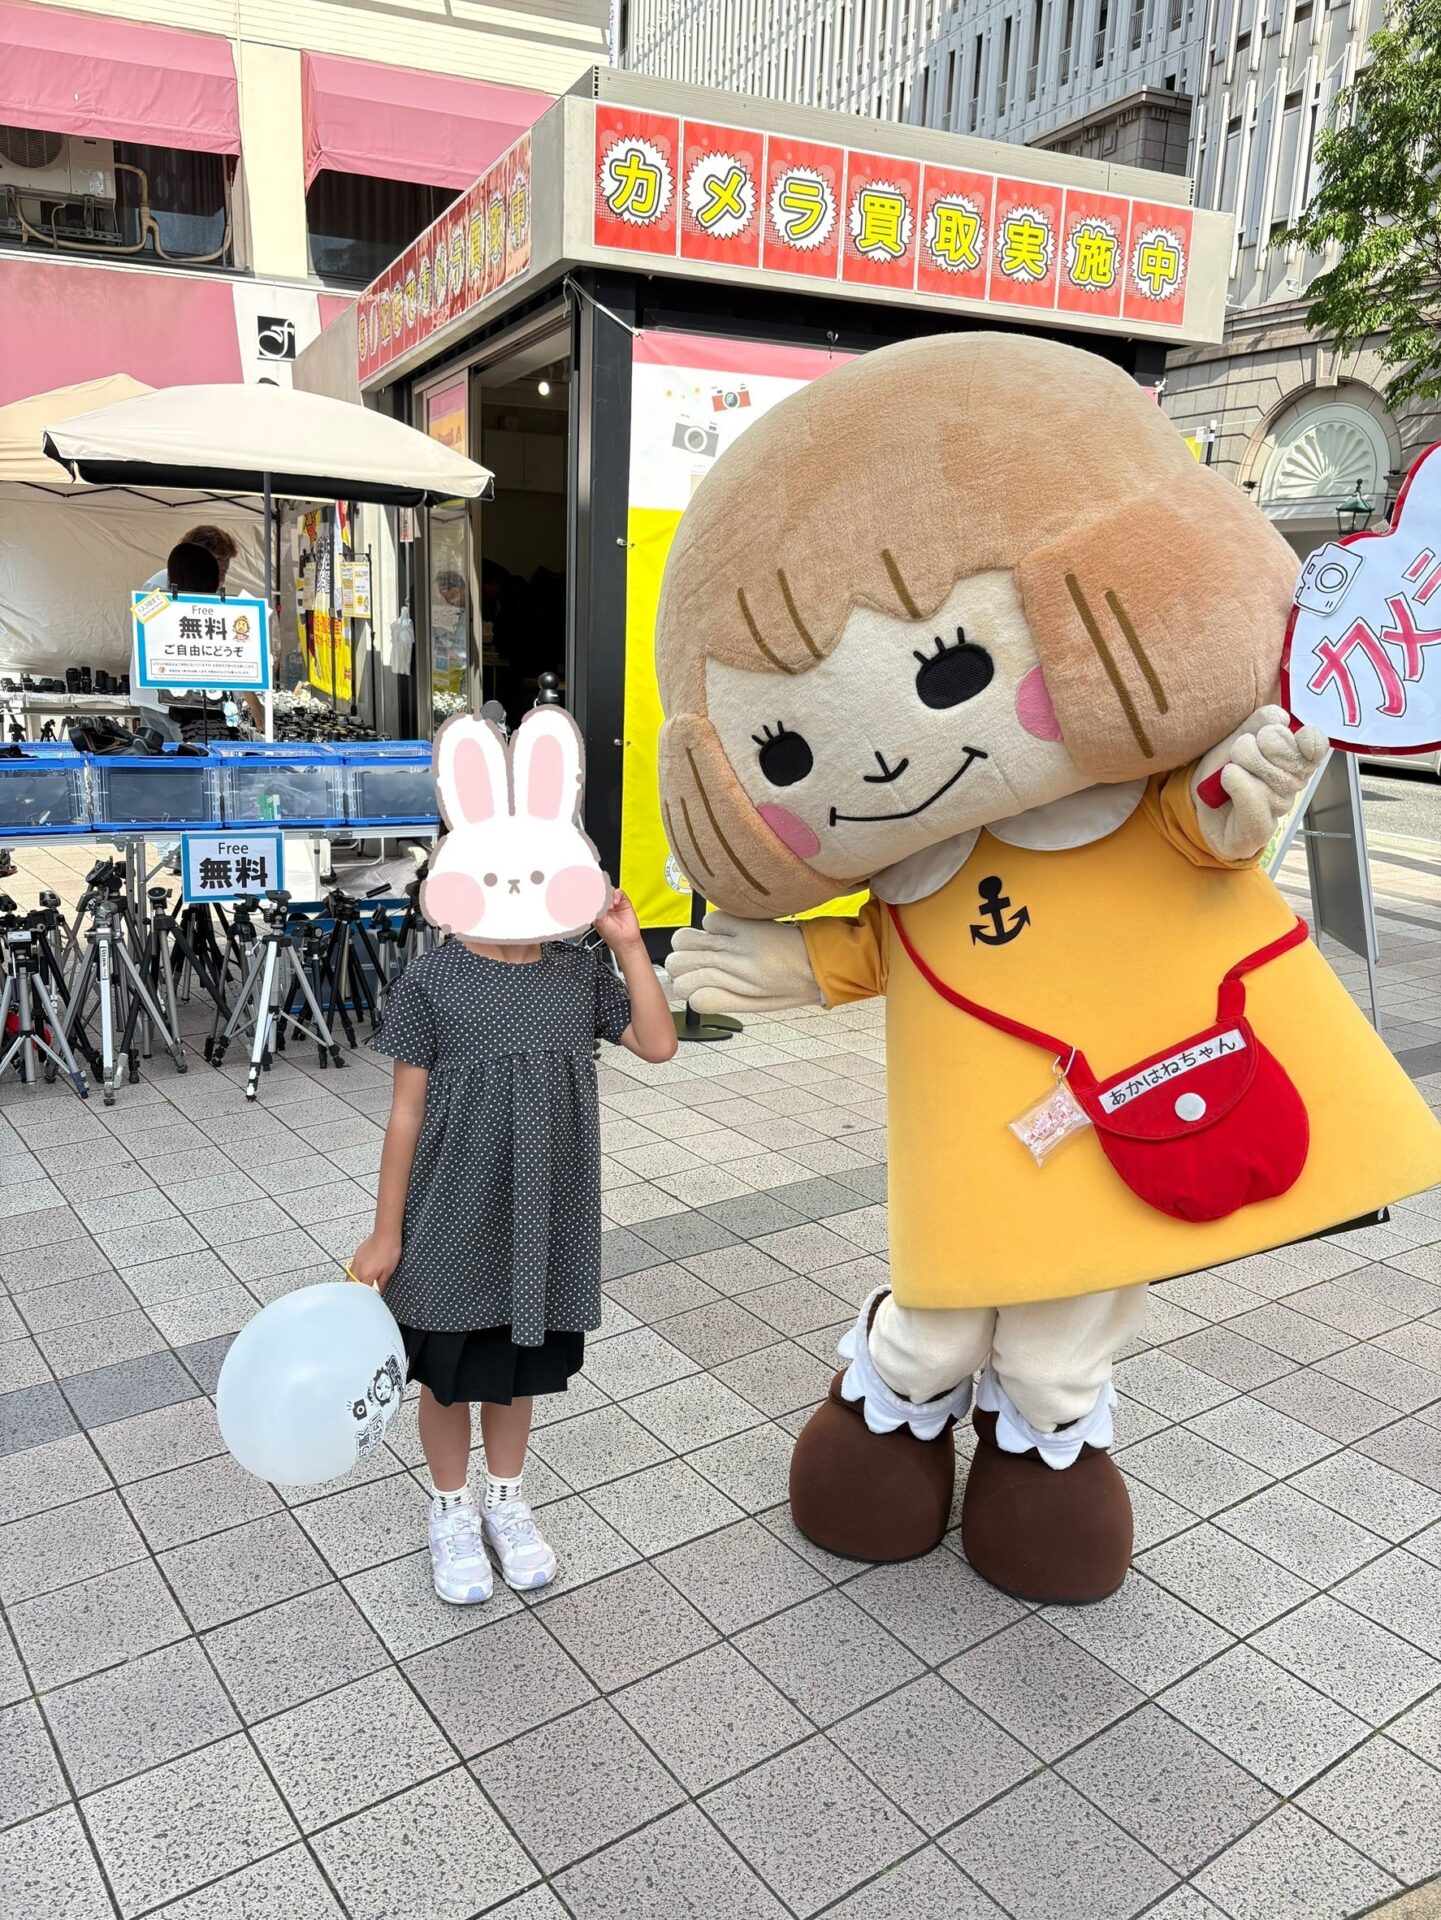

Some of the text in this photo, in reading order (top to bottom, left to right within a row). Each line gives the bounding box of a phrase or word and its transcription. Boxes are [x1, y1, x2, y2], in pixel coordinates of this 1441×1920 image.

[608, 149, 1182, 298] カメラ買取実施中
[192, 605, 214, 615] Free
[179, 616, 228, 640] 無料
[164, 644, 244, 658] ご自由にどうぞ
[217, 842, 249, 855] Free
[198, 856, 269, 890] 無料
[1109, 1037, 1236, 1106] あかはねちゃん
